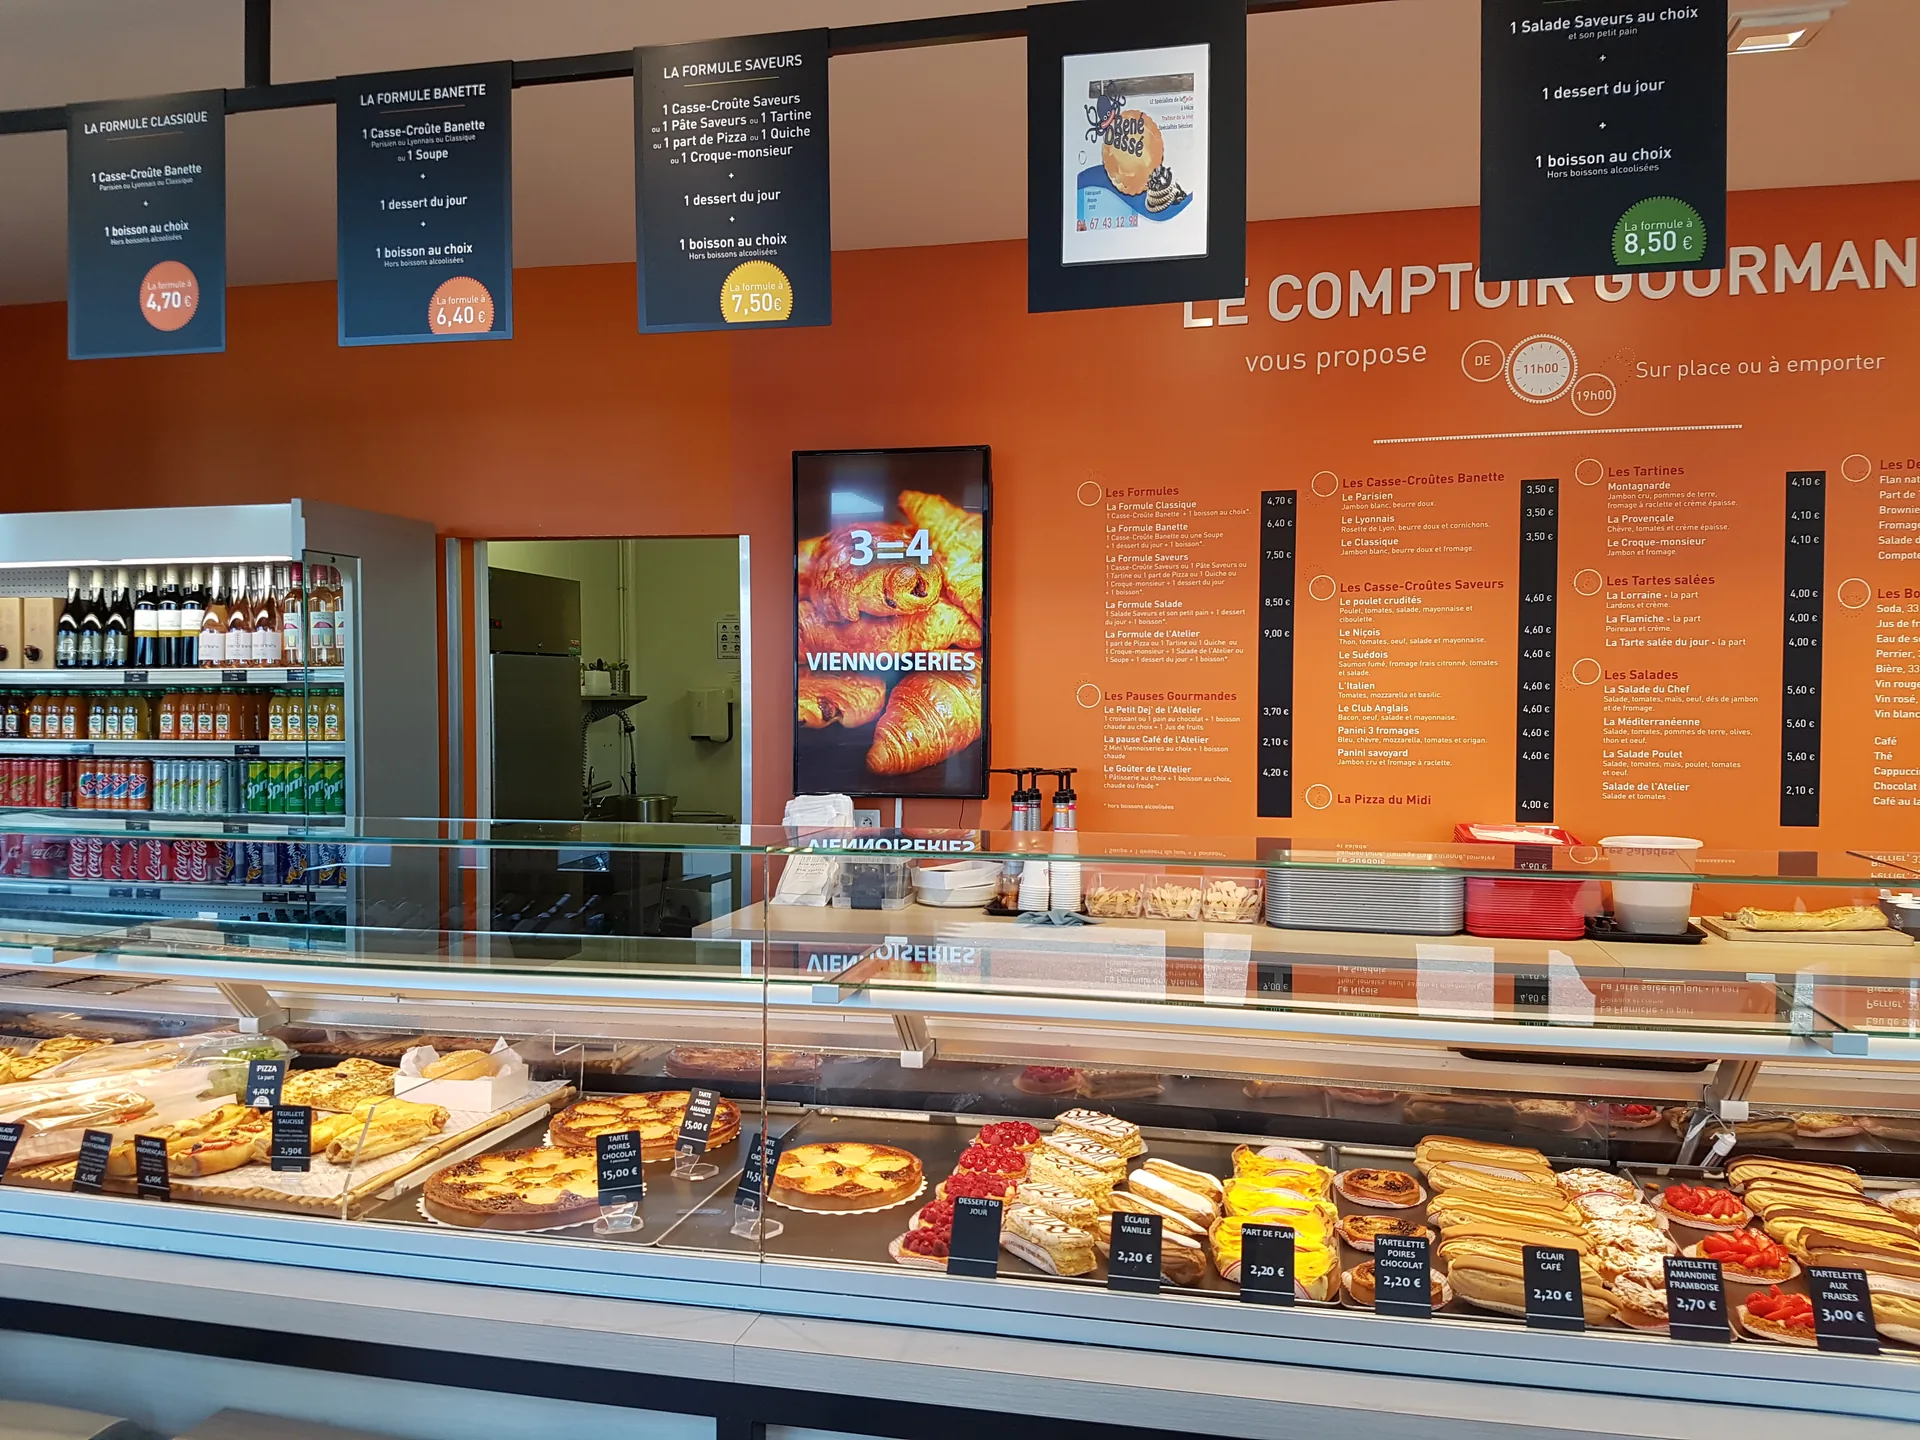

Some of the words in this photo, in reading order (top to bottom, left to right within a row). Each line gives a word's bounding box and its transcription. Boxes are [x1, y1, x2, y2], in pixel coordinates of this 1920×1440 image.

[1509, 22, 1516, 34] 1
[1522, 17, 1570, 33] Salade
[1574, 13, 1633, 30] Saveurs
[1637, 11, 1655, 22] au
[1660, 6, 1698, 21] choix
[1568, 32, 1577, 40] et
[1579, 31, 1595, 39] son
[1597, 28, 1617, 39] petit
[1619, 27, 1637, 38] pain
[663, 66, 679, 80] LA
[682, 60, 741, 77] FORMULE
[744, 54, 802, 72] SAVEURS
[360, 95, 374, 107] LA
[377, 89, 430, 105] FORMULE
[434, 84, 486, 101] BANETTE
[84, 123, 98, 135] LA
[100, 117, 148, 133] FORMULE
[151, 110, 208, 128] CLASSIQUE
[1114, 112, 1145, 135] René
[397, 155, 406, 163] ou
[407, 150, 413, 161] 1
[416, 149, 448, 162] Soupe
[670, 157, 679, 165] ou
[681, 152, 687, 164] 1
[690, 145, 793, 164] Croque-monsieur
[91, 173, 96, 184] 1
[99, 166, 162, 183] Casse-Croûte
[165, 163, 202, 178] Banette
[1624, 231, 1677, 257] 8,50
[1682, 235, 1693, 250] €
[384, 259, 400, 268] Hors
[401, 258, 427, 267] boissons
[429, 256, 464, 266] alcoolisées
[1268, 262, 1574, 322] COMPTOIR
[146, 291, 181, 312] 4,70
[184, 295, 192, 308] €
[437, 296, 447, 305] La
[448, 294, 478, 304] formule
[480, 294, 486, 303] à
[436, 305, 474, 327] 6,40
[477, 310, 486, 324] €
[1246, 352, 1307, 374] vous
[1315, 343, 1427, 375] propose
[1473, 355, 1491, 367] DE
[1523, 361, 1559, 376] 11h00
[1635, 361, 1671, 378] Sur
[1678, 359, 1731, 381] place
[1738, 359, 1761, 374] ou
[1768, 355, 1780, 373] à
[1787, 354, 1885, 381] emporter
[1576, 389, 1613, 402] 19h00
[1608, 466, 1630, 477] Les
[1633, 465, 1684, 477] Tartines
[1342, 478, 1363, 488] Les
[1366, 474, 1454, 488] Casse-Croûtes
[1458, 472, 1505, 484] Banette
[1791, 477, 1812, 488] 4,10
[1814, 478, 1821, 486] €
[1105, 487, 1125, 498] Les
[1127, 486, 1179, 498] Formules
[1608, 480, 1671, 493] Montagnarde
[1267, 496, 1286, 506] 4,70
[1342, 492, 1353, 502] Le
[1355, 491, 1393, 501] Parisien
[1106, 502, 1117, 511] La
[1118, 501, 1153, 510] Formule
[1155, 500, 1196, 511] Classique
[1341, 503, 1369, 511] Jambon
[1393, 500, 1416, 509] beurre
[849, 528, 933, 567] 3=4
[806, 652, 976, 672] VIENNOISERIES
[1604, 669, 1626, 680] Les
[1629, 669, 1678, 680] Salades
[1104, 691, 1123, 701] Les
[1126, 691, 1164, 701] Pauses
[1167, 691, 1237, 702] Gourmandes
[1874, 736, 1898, 746] Café
[1873, 751, 1893, 761] Thé
[1602, 782, 1635, 792] Salade
[1638, 782, 1649, 792] de
[1651, 782, 1690, 792] l'Atelier
[1337, 794, 1351, 804] La
[1354, 794, 1386, 805] Pizza
[1388, 794, 1403, 805] du
[1406, 795, 1432, 805] Midi
[1121, 803, 1143, 811] boissons
[1144, 803, 1174, 811] alcoolisées
[256, 1064, 278, 1073] PIZZA
[698, 1090, 712, 1099] TARTE
[694, 1098, 711, 1107] POIRES
[689, 1105, 712, 1115] AMANDES
[278, 1117, 305, 1125] SAUCISSE
[684, 1120, 703, 1131] 15,00
[703, 1123, 709, 1132] €
[608, 1134, 629, 1143] TARTE
[607, 1142, 631, 1151] POIRES
[602, 1150, 637, 1161] CHOCOLAT
[602, 1168, 630, 1181] 15,00
[631, 1167, 638, 1176] €
[958, 1197, 990, 1208] DESSERT
[991, 1198, 1000, 1208] DU
[969, 1207, 988, 1217] JOUR
[1124, 1213, 1151, 1226] ÉCLAIR
[1121, 1225, 1152, 1236] VANILLE
[1241, 1228, 1262, 1238] PART
[1263, 1229, 1273, 1239] DE
[1273, 1230, 1294, 1240] FLAN
[1378, 1238, 1426, 1250] TARTELETTE
[1117, 1250, 1144, 1264] 2,20
[1145, 1253, 1153, 1264] €
[1387, 1248, 1416, 1260] POIRES
[1536, 1250, 1565, 1262] ÉCLAIR
[1380, 1259, 1423, 1270] CHOCOLAT
[1540, 1261, 1562, 1272] CAFÉ
[1666, 1259, 1719, 1271] TARTELETTE
[1250, 1264, 1275, 1277] 2,20
[1277, 1267, 1285, 1278] €
[1669, 1270, 1718, 1282] AMANDINE
[1811, 1268, 1864, 1281] TARTELETTE
[1383, 1275, 1411, 1289] 2,20
[1413, 1277, 1422, 1288] €
[1669, 1280, 1720, 1293] FRAMBOISE
[1829, 1281, 1848, 1291] AUX
[1533, 1288, 1562, 1302] 2,20
[1564, 1290, 1573, 1302] €
[1822, 1291, 1859, 1303] FRAISES
[1676, 1297, 1706, 1311] 2,70
[1708, 1300, 1717, 1311] €
[1822, 1308, 1853, 1322] 3,00
[1856, 1311, 1866, 1323] €
